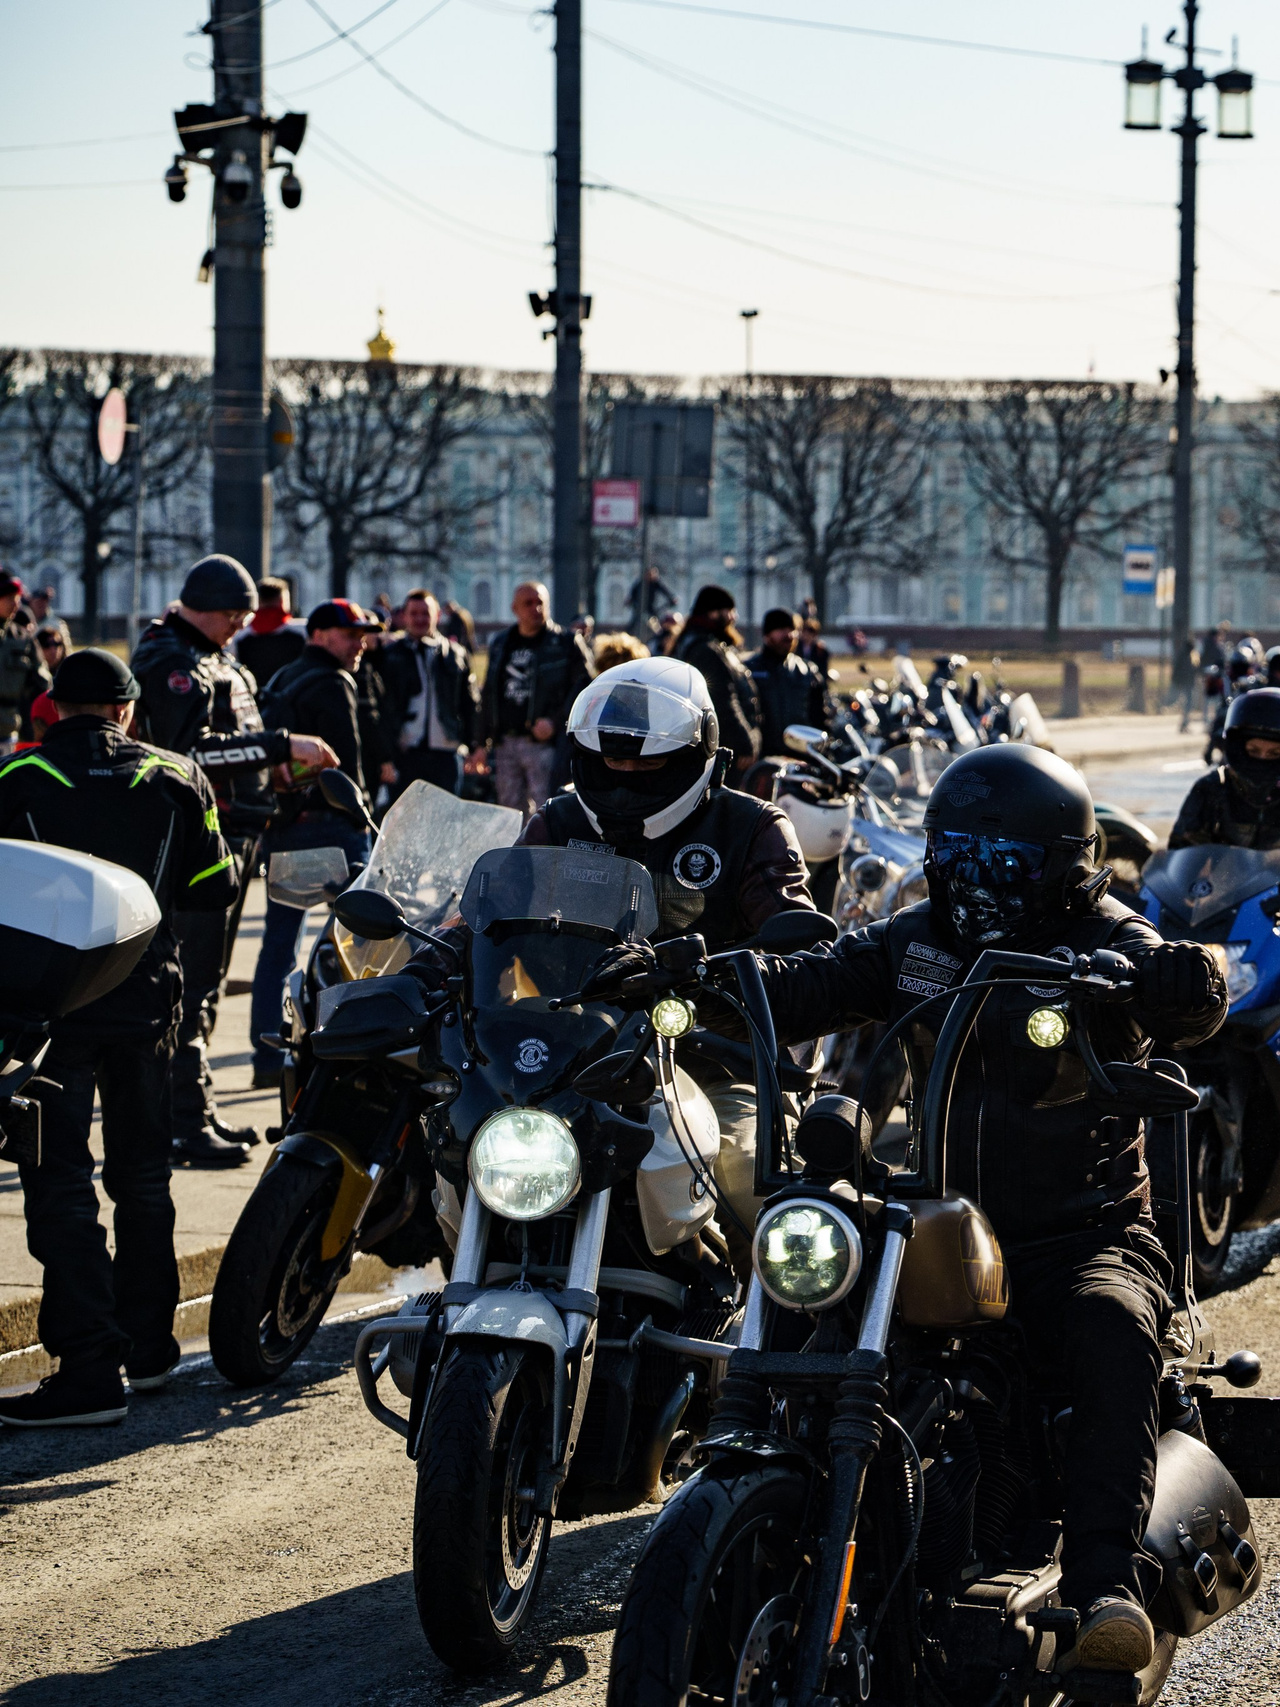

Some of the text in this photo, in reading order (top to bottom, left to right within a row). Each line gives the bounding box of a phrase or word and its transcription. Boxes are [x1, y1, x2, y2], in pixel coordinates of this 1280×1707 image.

[679, 844, 716, 856] SUPPORT CLUB
[902, 978, 943, 996] PROSPECT
[1033, 987, 1063, 997] HOOLIGA
